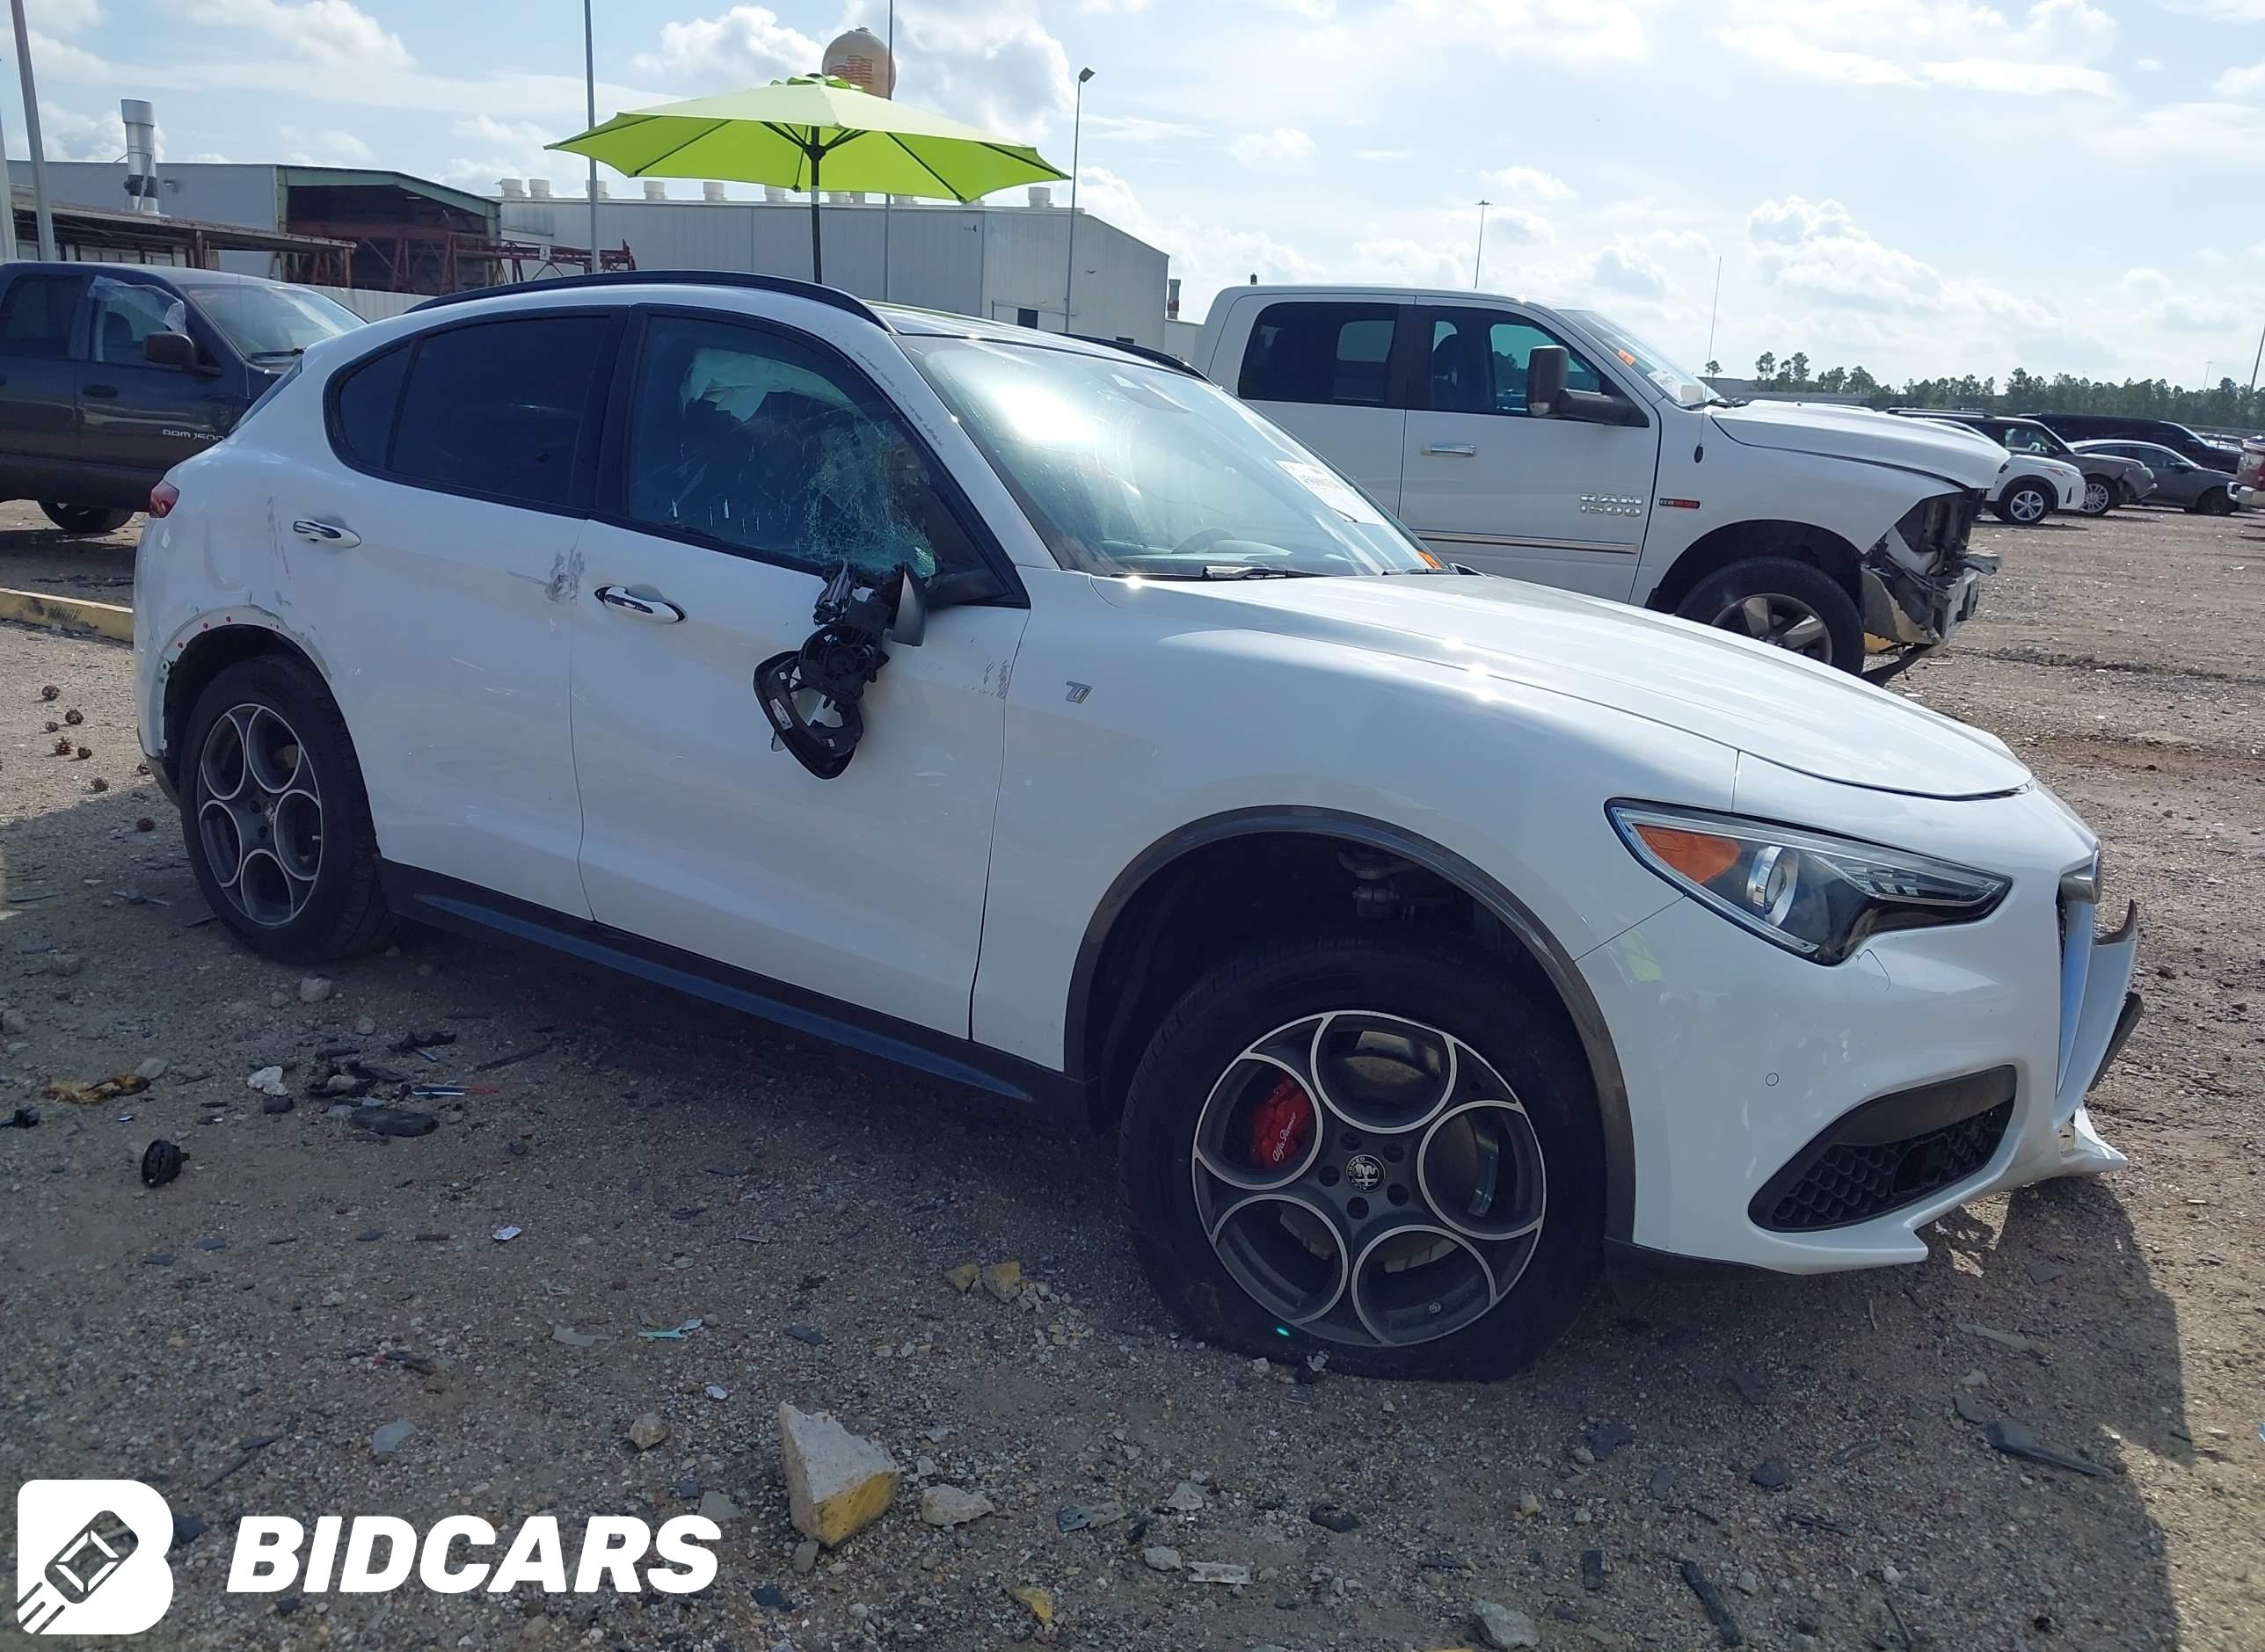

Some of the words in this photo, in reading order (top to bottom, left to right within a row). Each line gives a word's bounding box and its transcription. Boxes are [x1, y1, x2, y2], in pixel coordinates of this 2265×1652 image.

[162, 429, 191, 439] RAM
[1580, 492, 1642, 505] RAM
[1580, 504, 1642, 517] 1500
[1272, 1141, 1285, 1161] Alfa
[1279, 1112, 1297, 1142] Romeo
